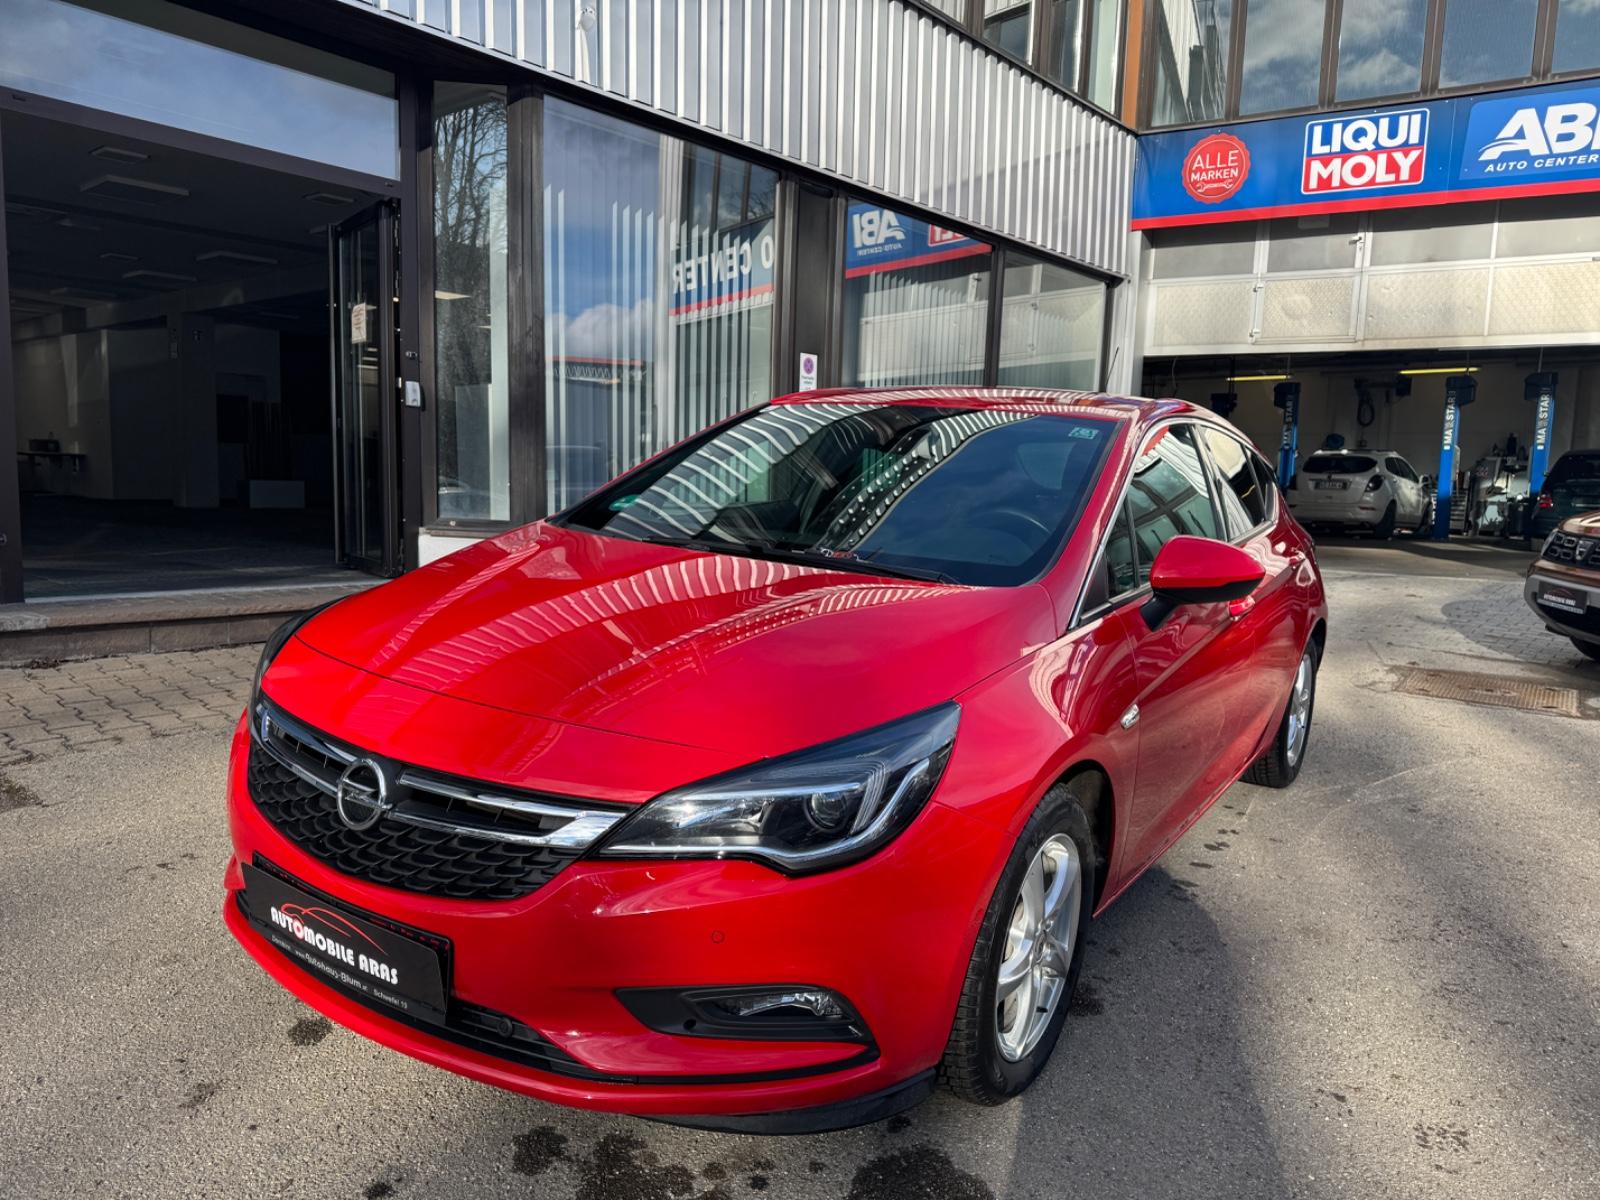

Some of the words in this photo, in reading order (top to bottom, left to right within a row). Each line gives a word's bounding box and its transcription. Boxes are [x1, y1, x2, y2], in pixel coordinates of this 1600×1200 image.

[1311, 113, 1422, 155] LIQUI
[1190, 168, 1239, 182] MARKEN
[1192, 150, 1239, 170] ALLE
[1308, 149, 1423, 189] MOLY
[1484, 160, 1528, 173] AUTO
[1534, 154, 1598, 168] CENTER
[270, 905, 355, 967] AUTOMOBILE
[358, 953, 399, 985] ARAS
